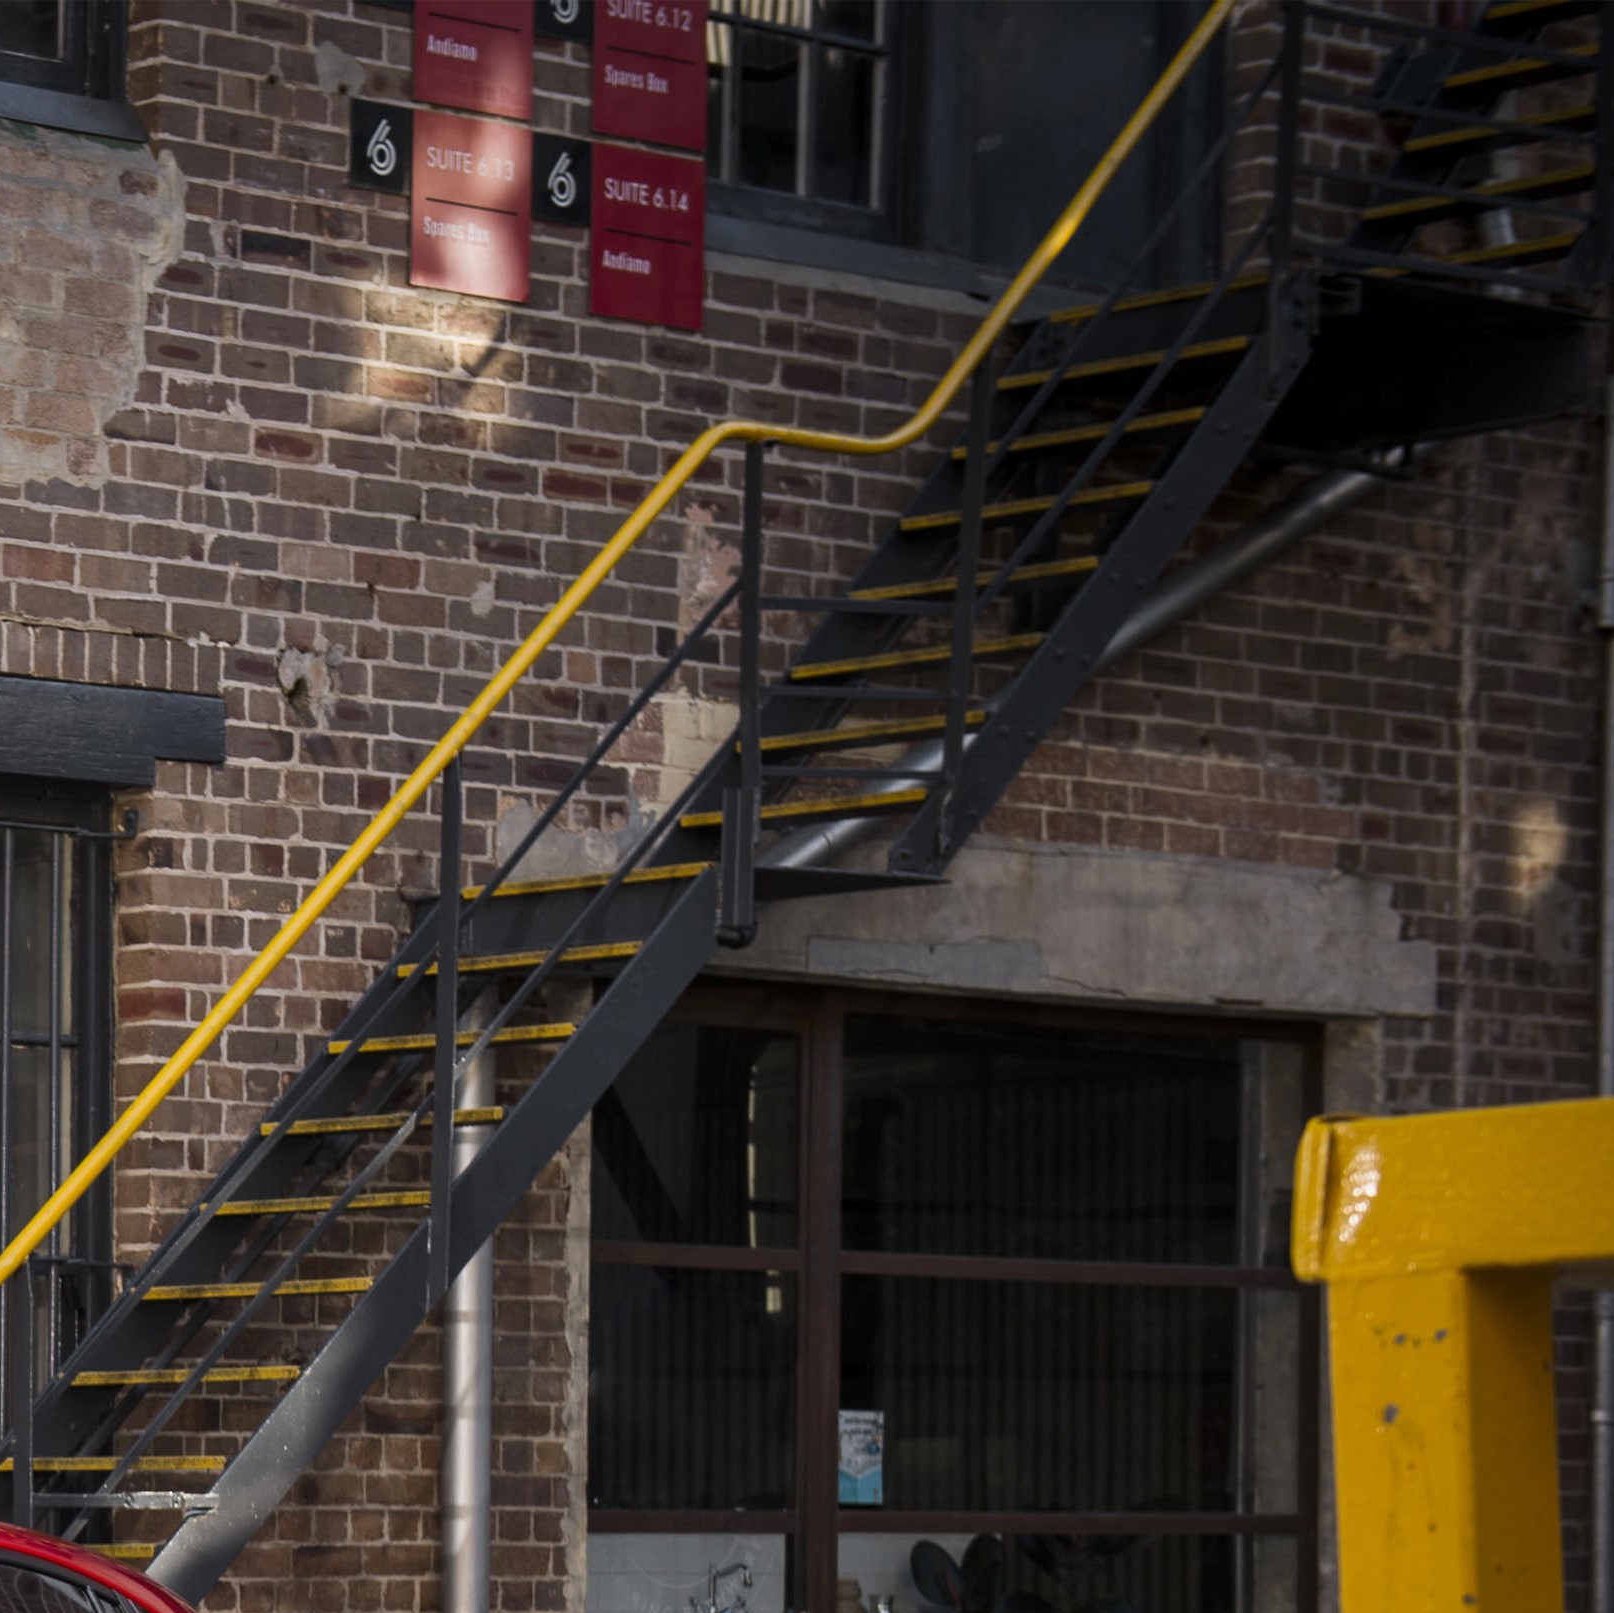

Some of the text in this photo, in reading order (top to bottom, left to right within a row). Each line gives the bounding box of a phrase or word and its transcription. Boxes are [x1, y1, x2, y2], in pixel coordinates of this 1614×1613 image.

[606, 0, 652, 24] SUITE
[655, 6, 692, 32] 6.12
[426, 34, 479, 62] Andiamo
[604, 64, 670, 94] Spares Box
[367, 118, 397, 176] 6
[426, 146, 516, 182] SUITE 6.13
[547, 152, 577, 208] 6
[604, 177, 689, 212] SUITE 6.14
[601, 249, 652, 275] Andiamo
